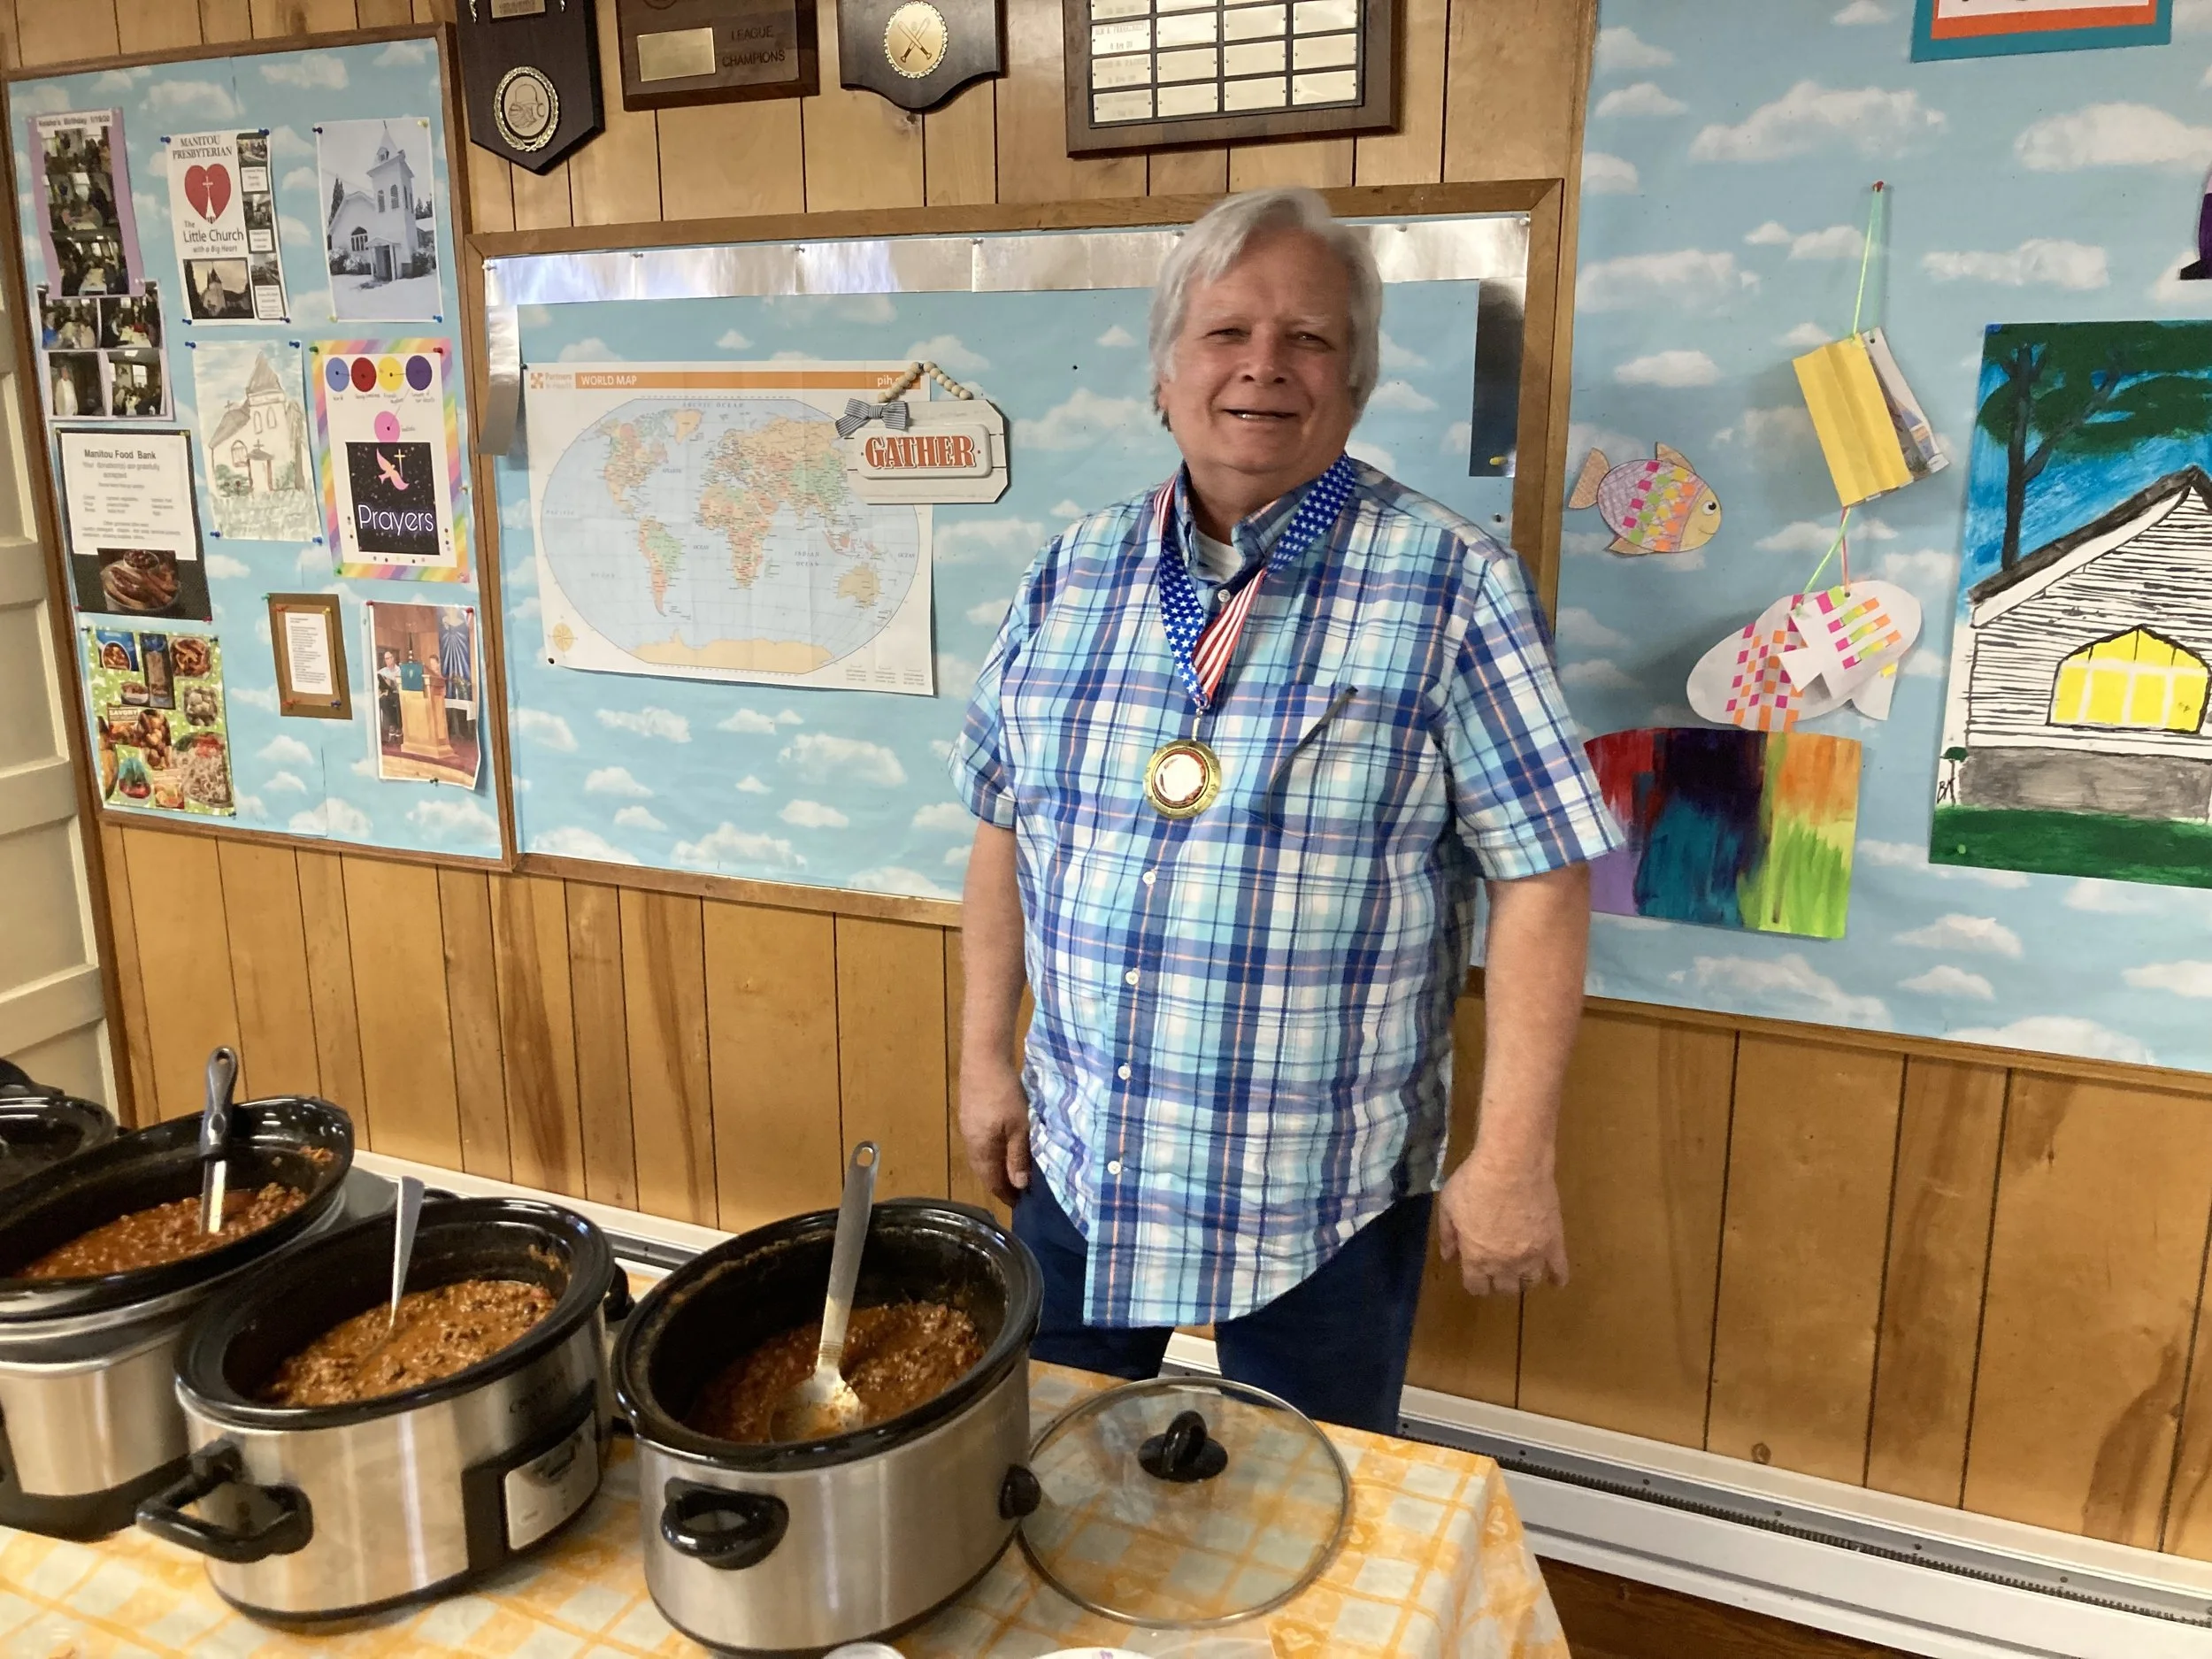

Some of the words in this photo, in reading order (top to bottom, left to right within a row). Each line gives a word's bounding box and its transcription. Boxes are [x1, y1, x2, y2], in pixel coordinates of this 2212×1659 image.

[731, 25, 774, 41] LEAGUE
[722, 50, 786, 68] CHAMPIONS
[180, 134, 220, 147] MANITOU
[173, 146, 233, 160] PRESBYTERIAN
[184, 219, 195, 228] The
[183, 229, 207, 243] Little
[209, 227, 244, 242] Church
[211, 244, 220, 255] Big
[580, 375, 614, 386] WORLD
[617, 375, 637, 386] MAP
[84, 449, 113, 458] Manitou
[114, 450, 134, 459] Food
[137, 450, 157, 459] Bank
[864, 434, 977, 468] GATHER
[358, 504, 434, 536] Prayers
